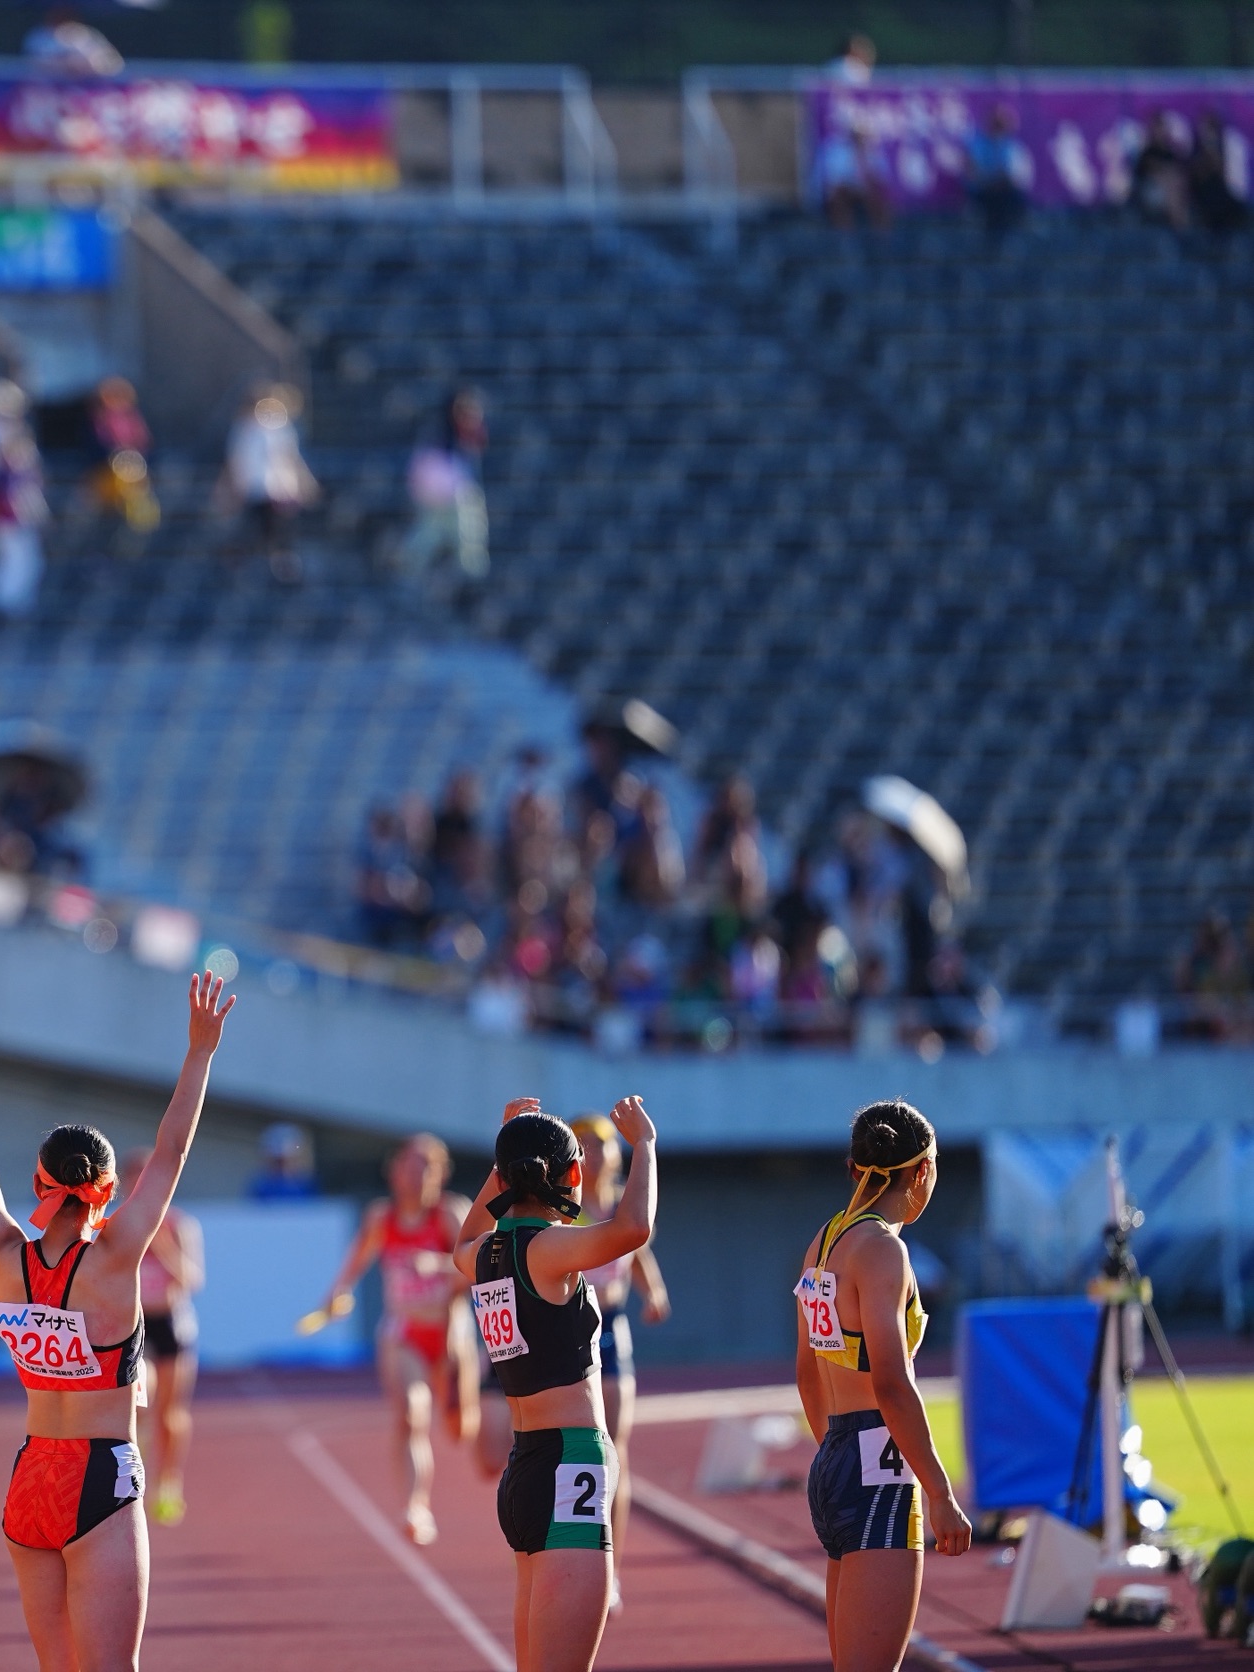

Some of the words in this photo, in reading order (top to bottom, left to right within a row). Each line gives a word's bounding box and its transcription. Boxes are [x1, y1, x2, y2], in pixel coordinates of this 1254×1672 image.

[481, 1287, 510, 1307] マイナビ
[31, 1312, 78, 1333] マイナビ
[476, 1308, 514, 1348] 439
[507, 1344, 524, 1356] 2025
[824, 1340, 841, 1348] 2025
[75, 1366, 95, 1376] 2025
[879, 1436, 904, 1477] 4
[572, 1471, 596, 1517] 2
